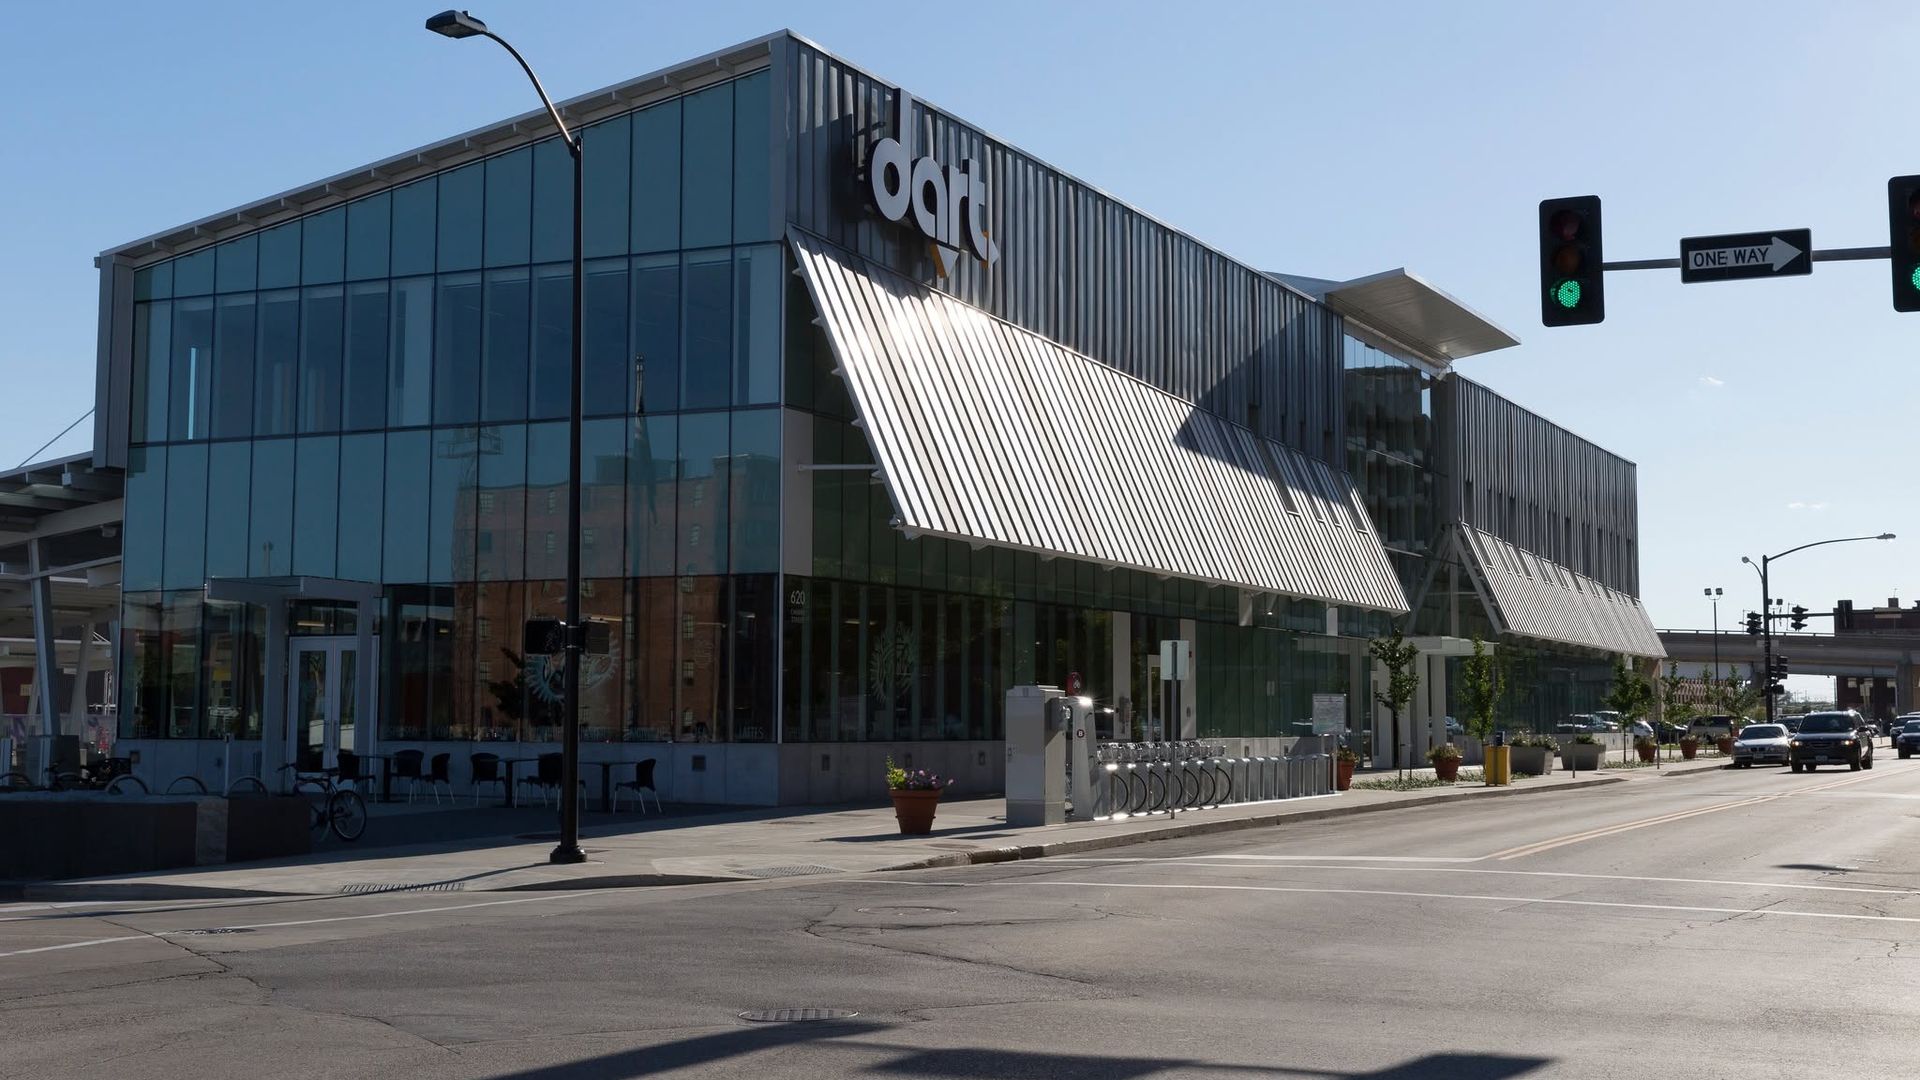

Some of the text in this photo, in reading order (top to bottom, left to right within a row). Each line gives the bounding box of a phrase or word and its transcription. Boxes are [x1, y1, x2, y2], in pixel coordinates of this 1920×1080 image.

[868, 88, 998, 265] dart
[1694, 247, 1769, 267] ONE WAY
[790, 590, 806, 605] 620
